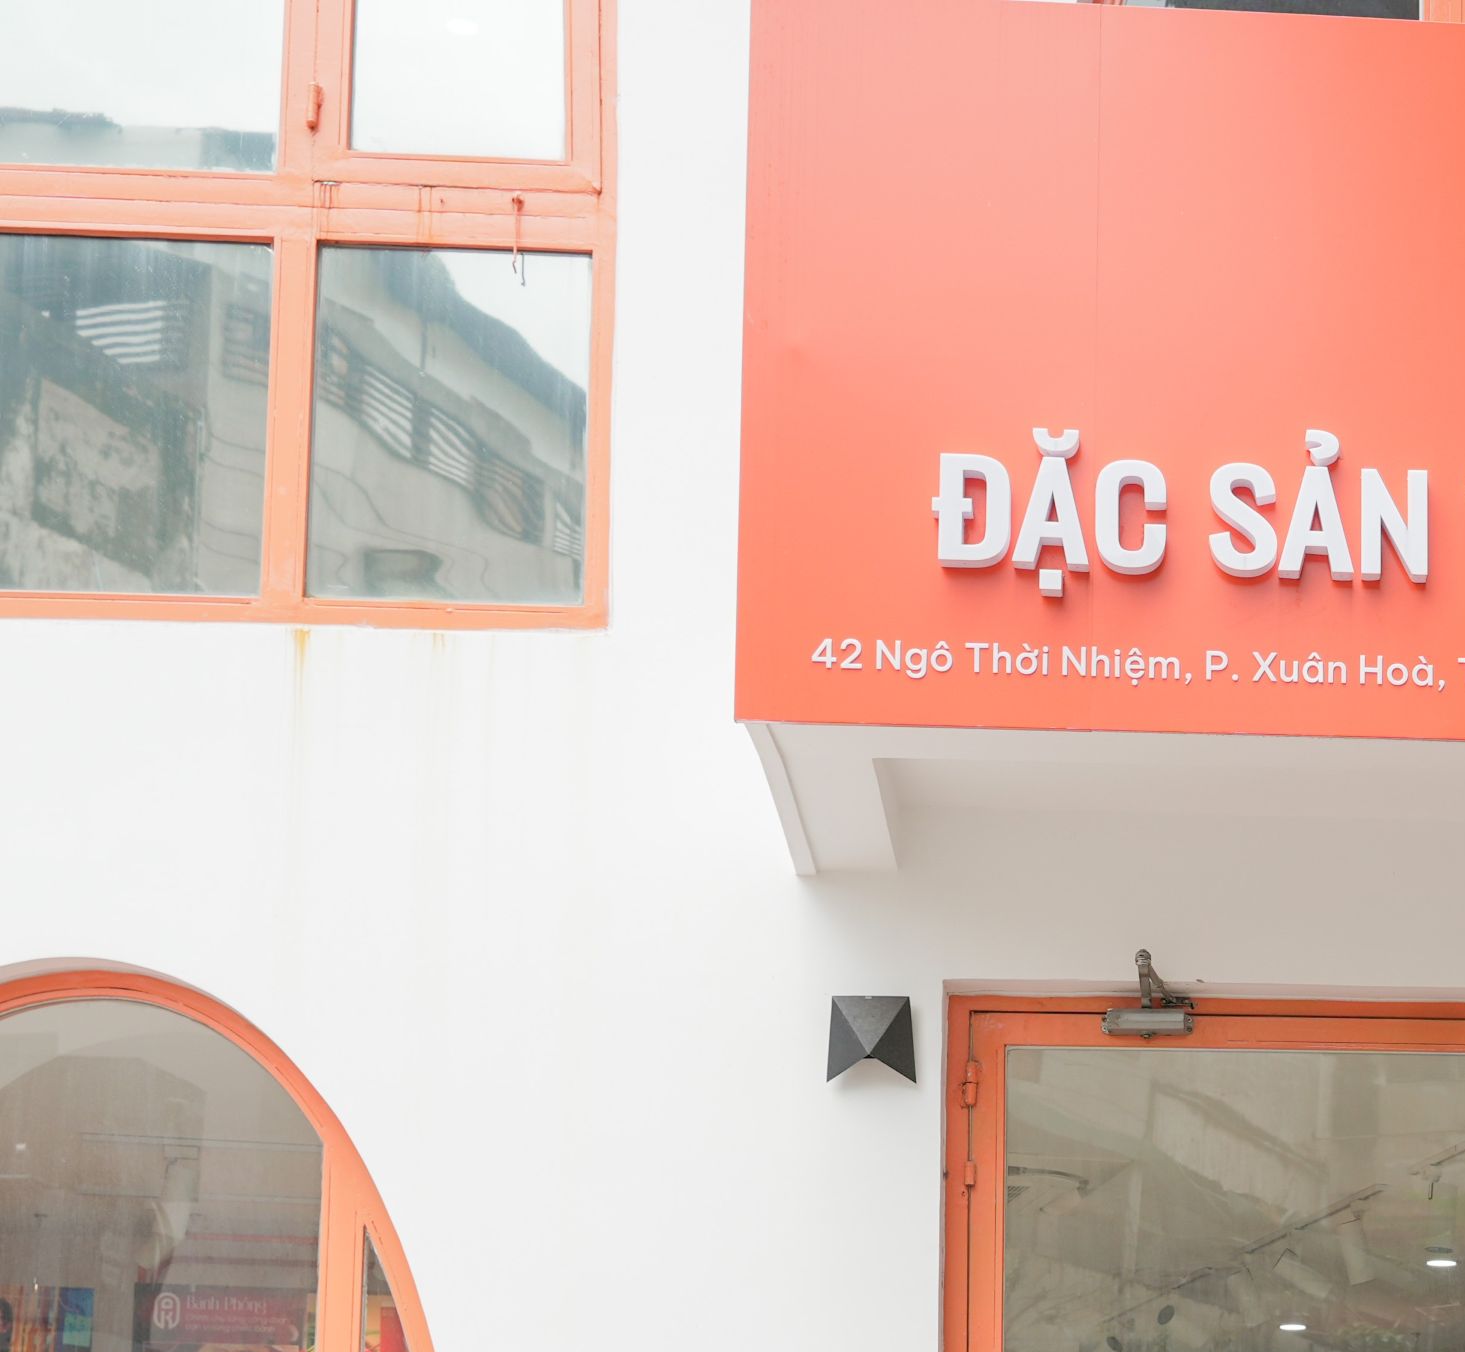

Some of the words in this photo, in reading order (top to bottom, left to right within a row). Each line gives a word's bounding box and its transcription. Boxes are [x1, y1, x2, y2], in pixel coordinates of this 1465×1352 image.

[932, 428, 1167, 597] ĐẶC
[1209, 430, 1428, 583] SẢN
[811, 638, 862, 669] 42
[875, 640, 953, 679] Ngô
[965, 643, 1049, 676] Thời
[1061, 646, 1192, 686] Nhiệm,
[1205, 650, 1240, 681] P.
[1252, 651, 1347, 684] Xuân
[1359, 655, 1446, 692] Hoà,
